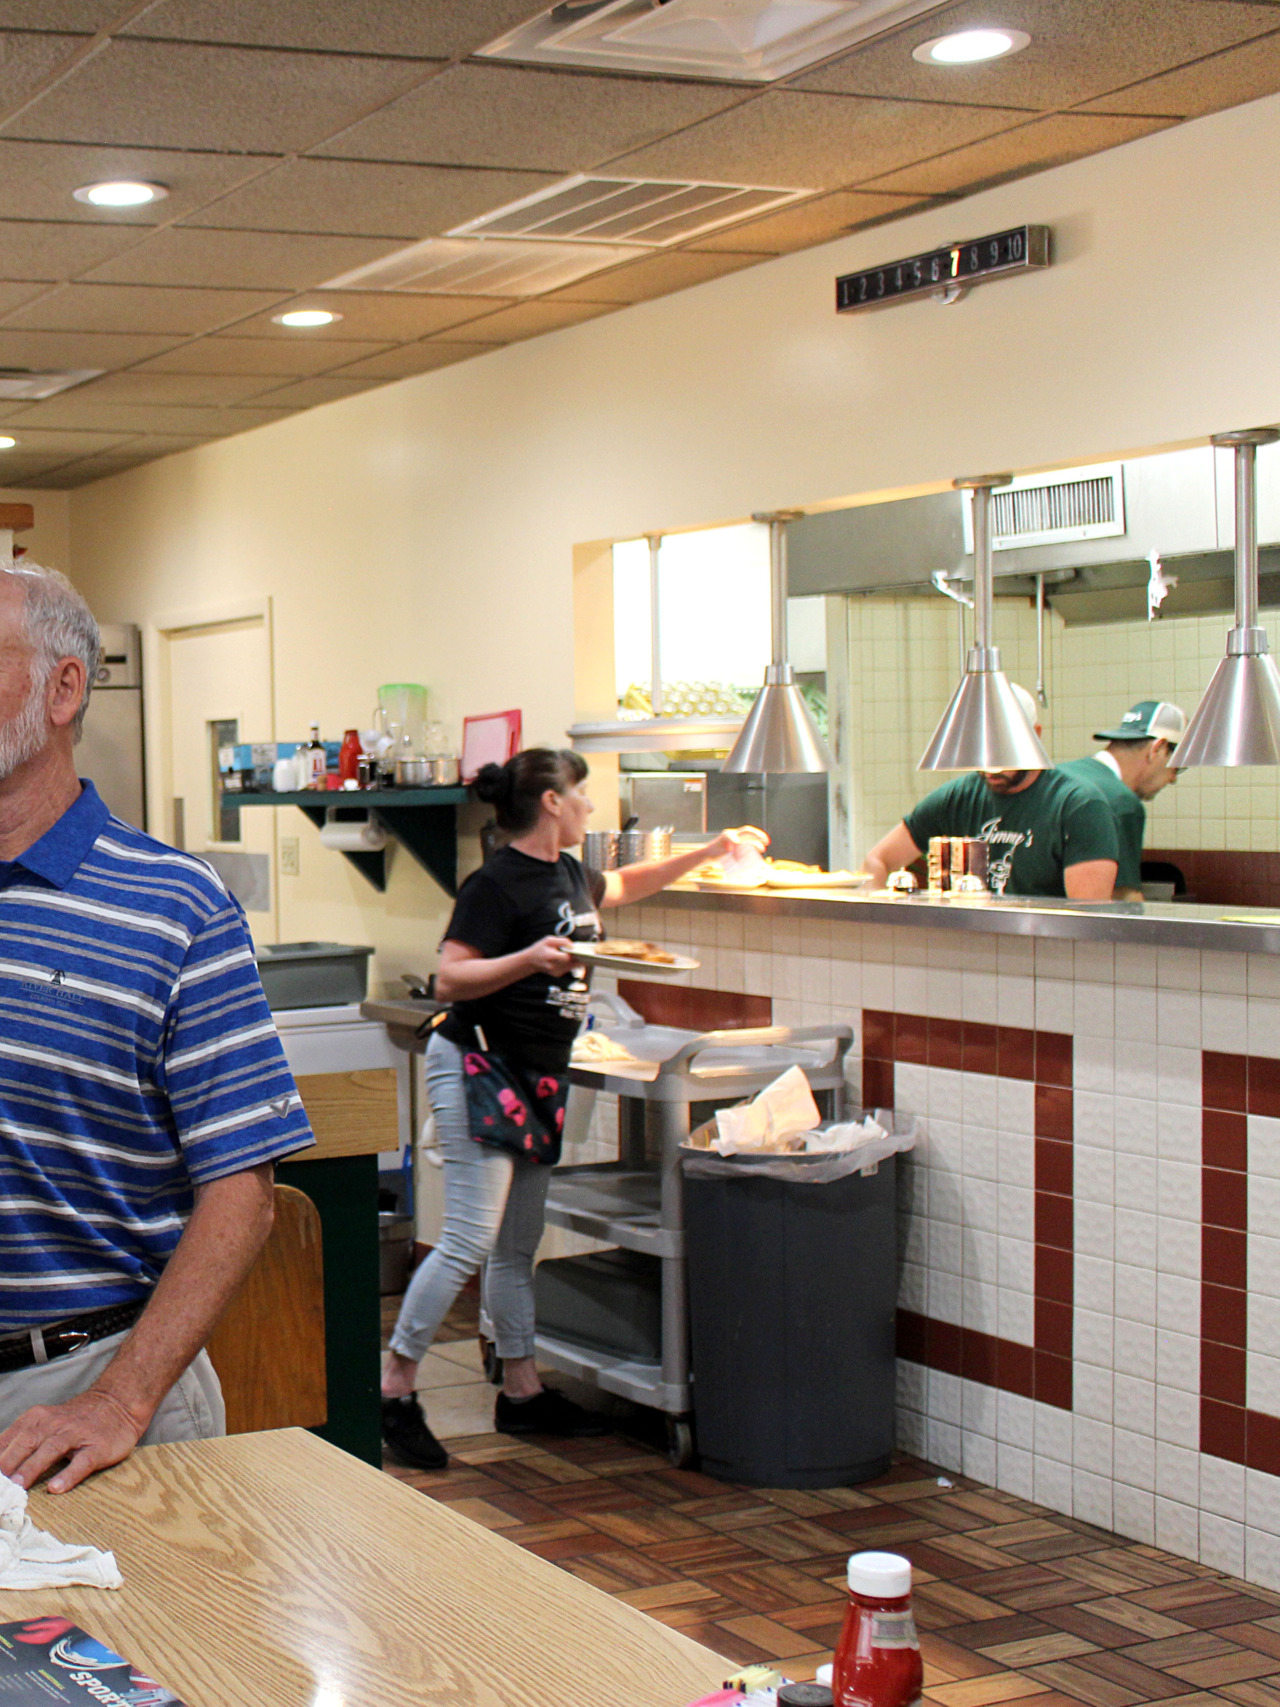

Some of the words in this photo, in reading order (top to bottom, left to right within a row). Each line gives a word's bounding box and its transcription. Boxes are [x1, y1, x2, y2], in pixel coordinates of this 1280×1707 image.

[859, 277, 867, 299] 2
[877, 273, 885, 296] 3
[895, 267, 903, 290] 4
[913, 262, 921, 286] 5
[931, 258, 939, 281] 6
[950, 249, 960, 277] 7
[970, 247, 978, 270] 8
[989, 241, 999, 266] 9
[1006, 234, 1022, 261] 10
